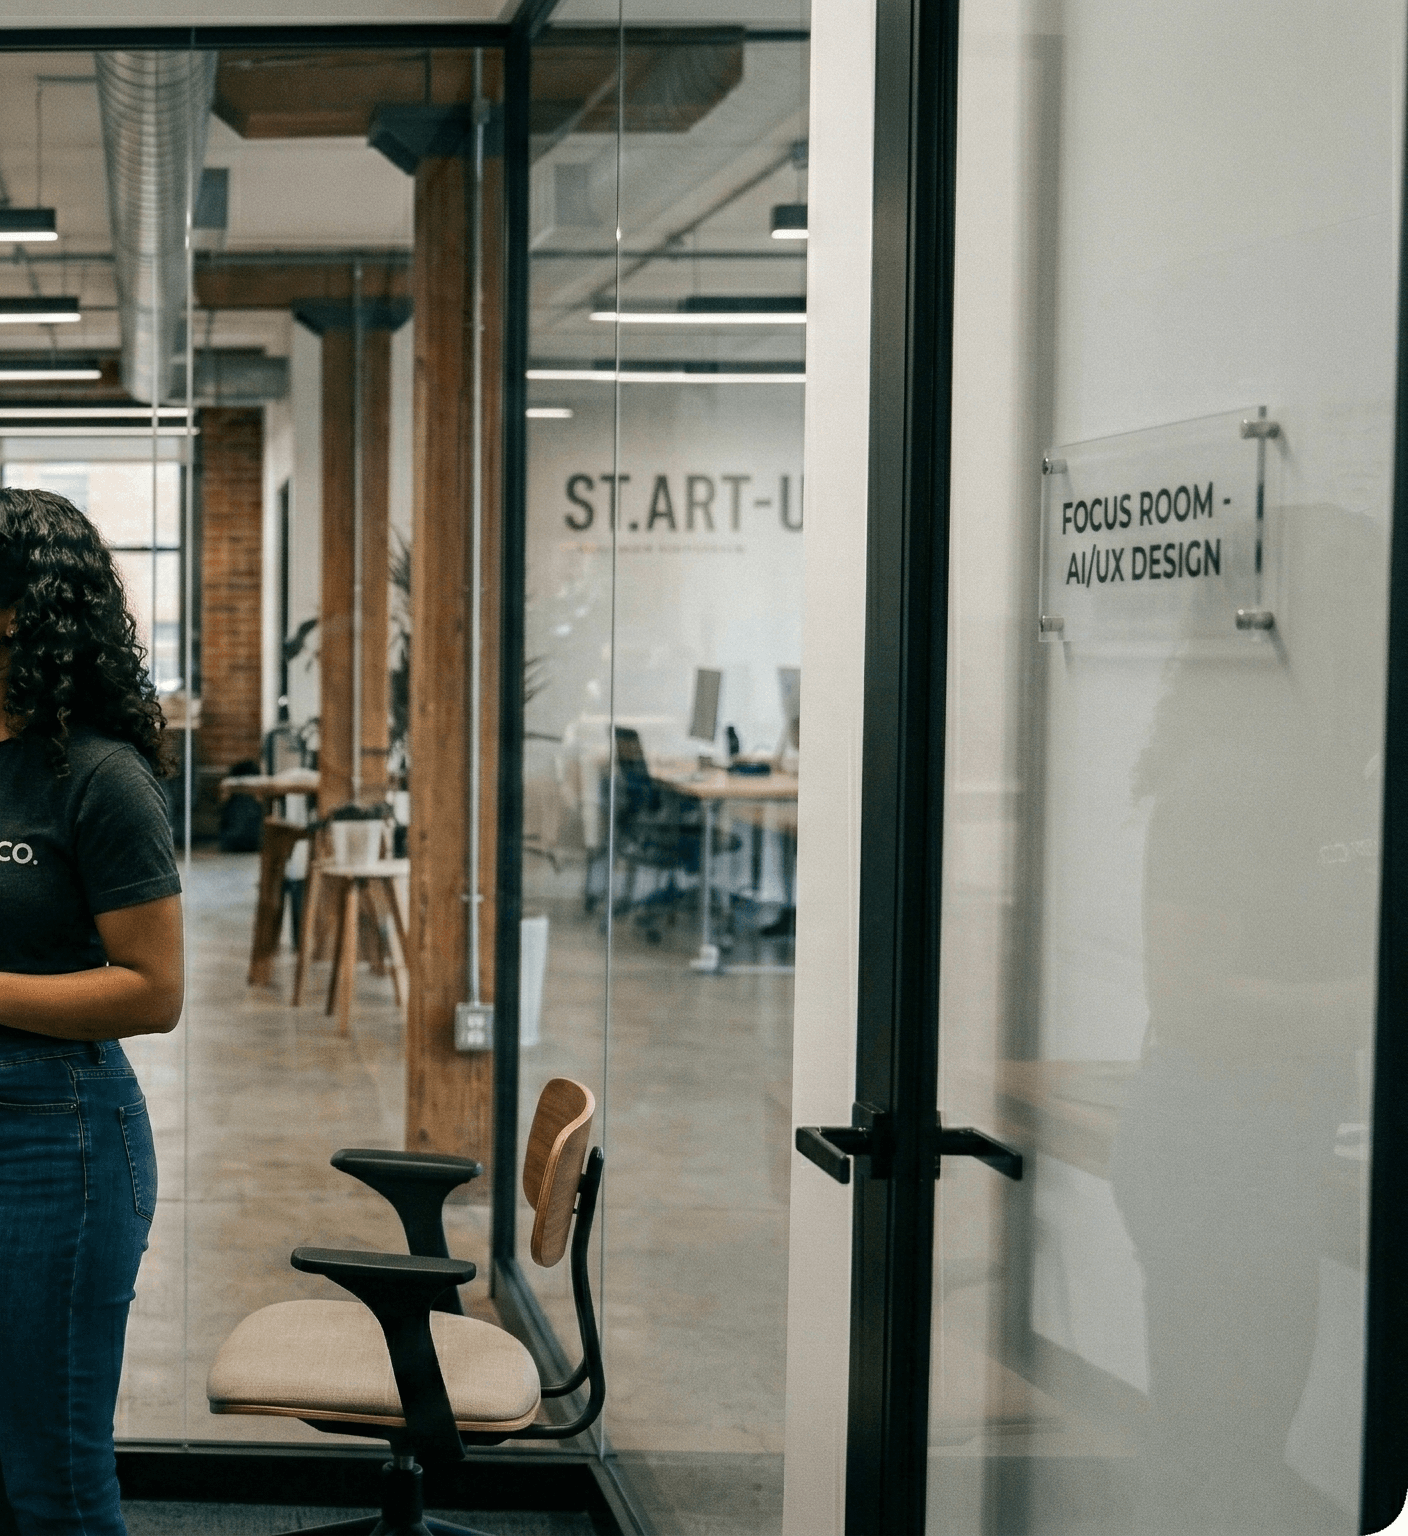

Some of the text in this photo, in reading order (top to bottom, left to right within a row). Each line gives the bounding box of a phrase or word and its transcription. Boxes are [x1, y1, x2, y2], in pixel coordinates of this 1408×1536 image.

[1062, 481, 1231, 535] FOCUS ROOM -
[1066, 538, 1221, 588] AI/UX DESIGN
